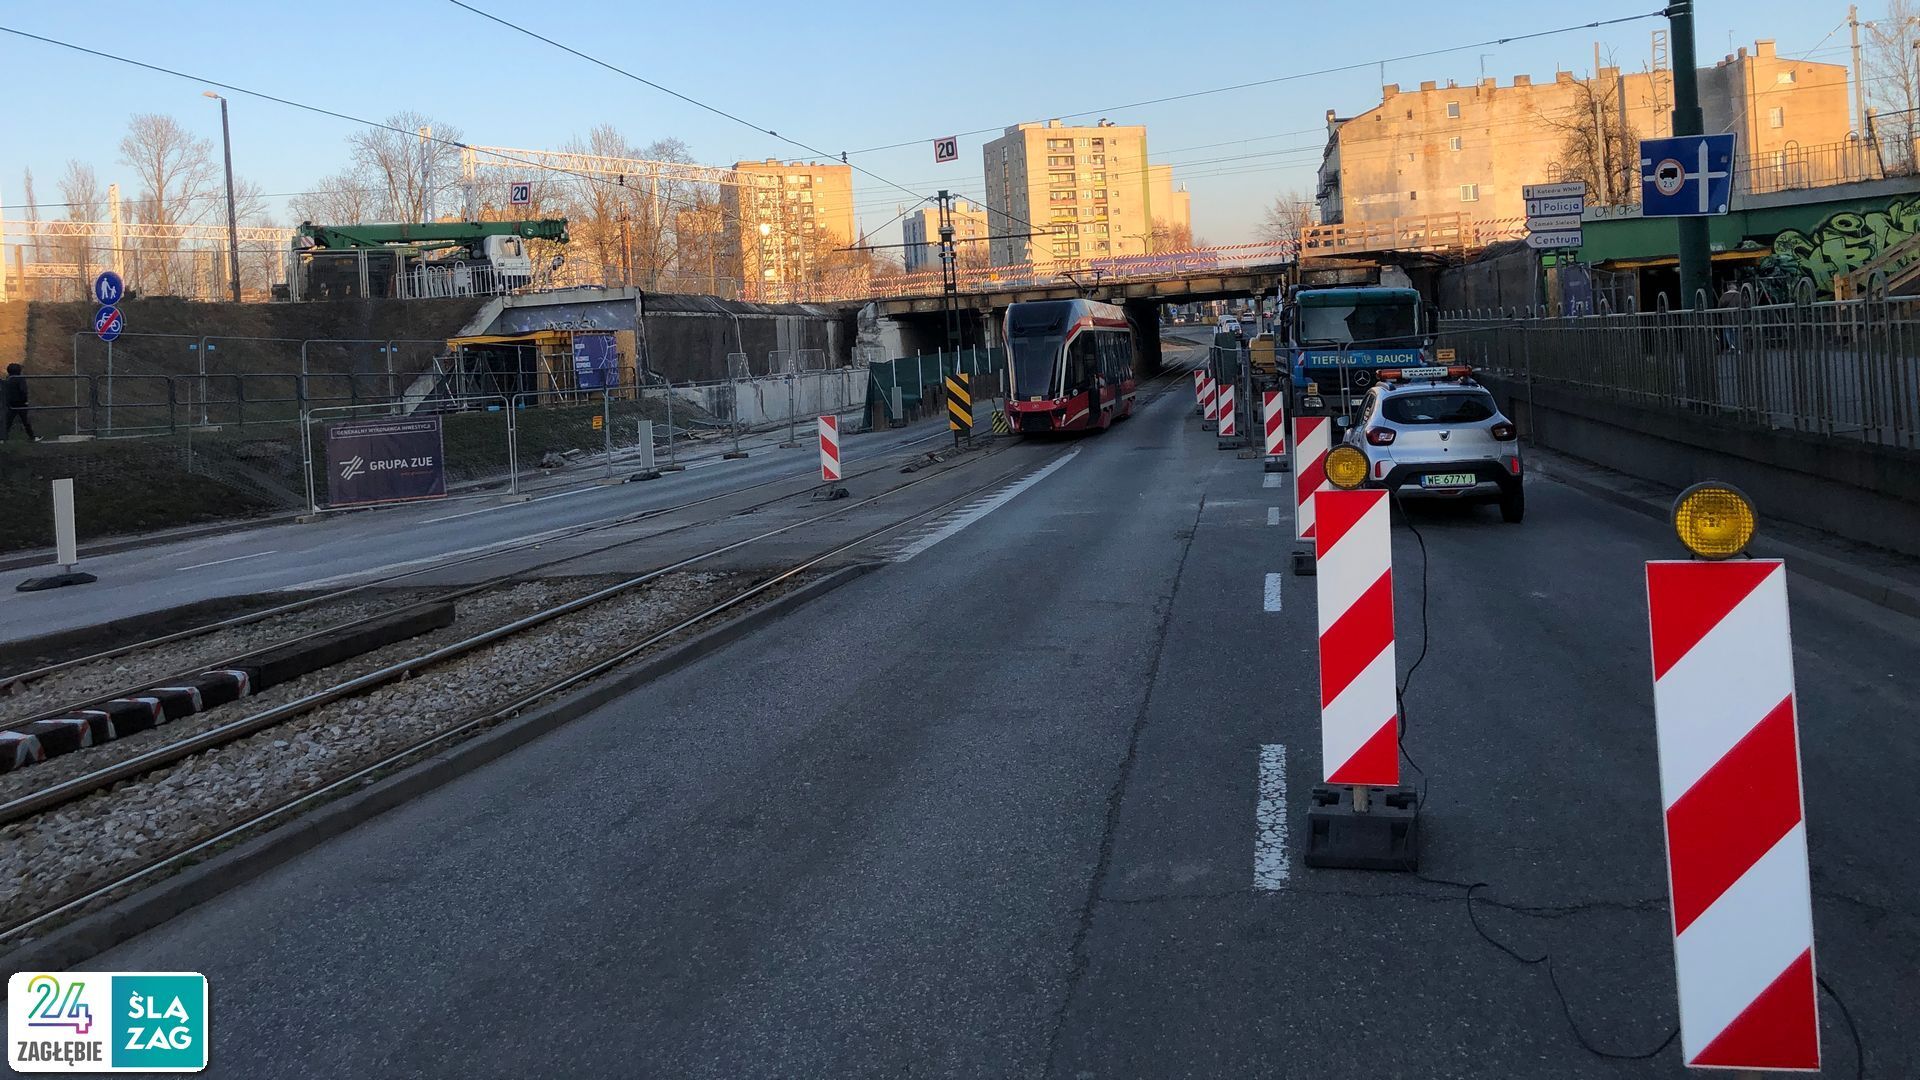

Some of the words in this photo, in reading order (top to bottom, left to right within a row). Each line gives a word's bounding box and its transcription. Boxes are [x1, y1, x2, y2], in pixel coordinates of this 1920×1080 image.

[938, 141, 954, 158] 20
[513, 186, 528, 201] 20
[1544, 202, 1579, 214] Policja
[1535, 236, 1579, 244] Centrum
[1376, 354, 1413, 363] BAUCH
[336, 427, 367, 436] GENERALNY
[369, 459, 409, 471] GRUPA
[411, 456, 433, 468] ZUE
[1427, 476, 1440, 485] WE
